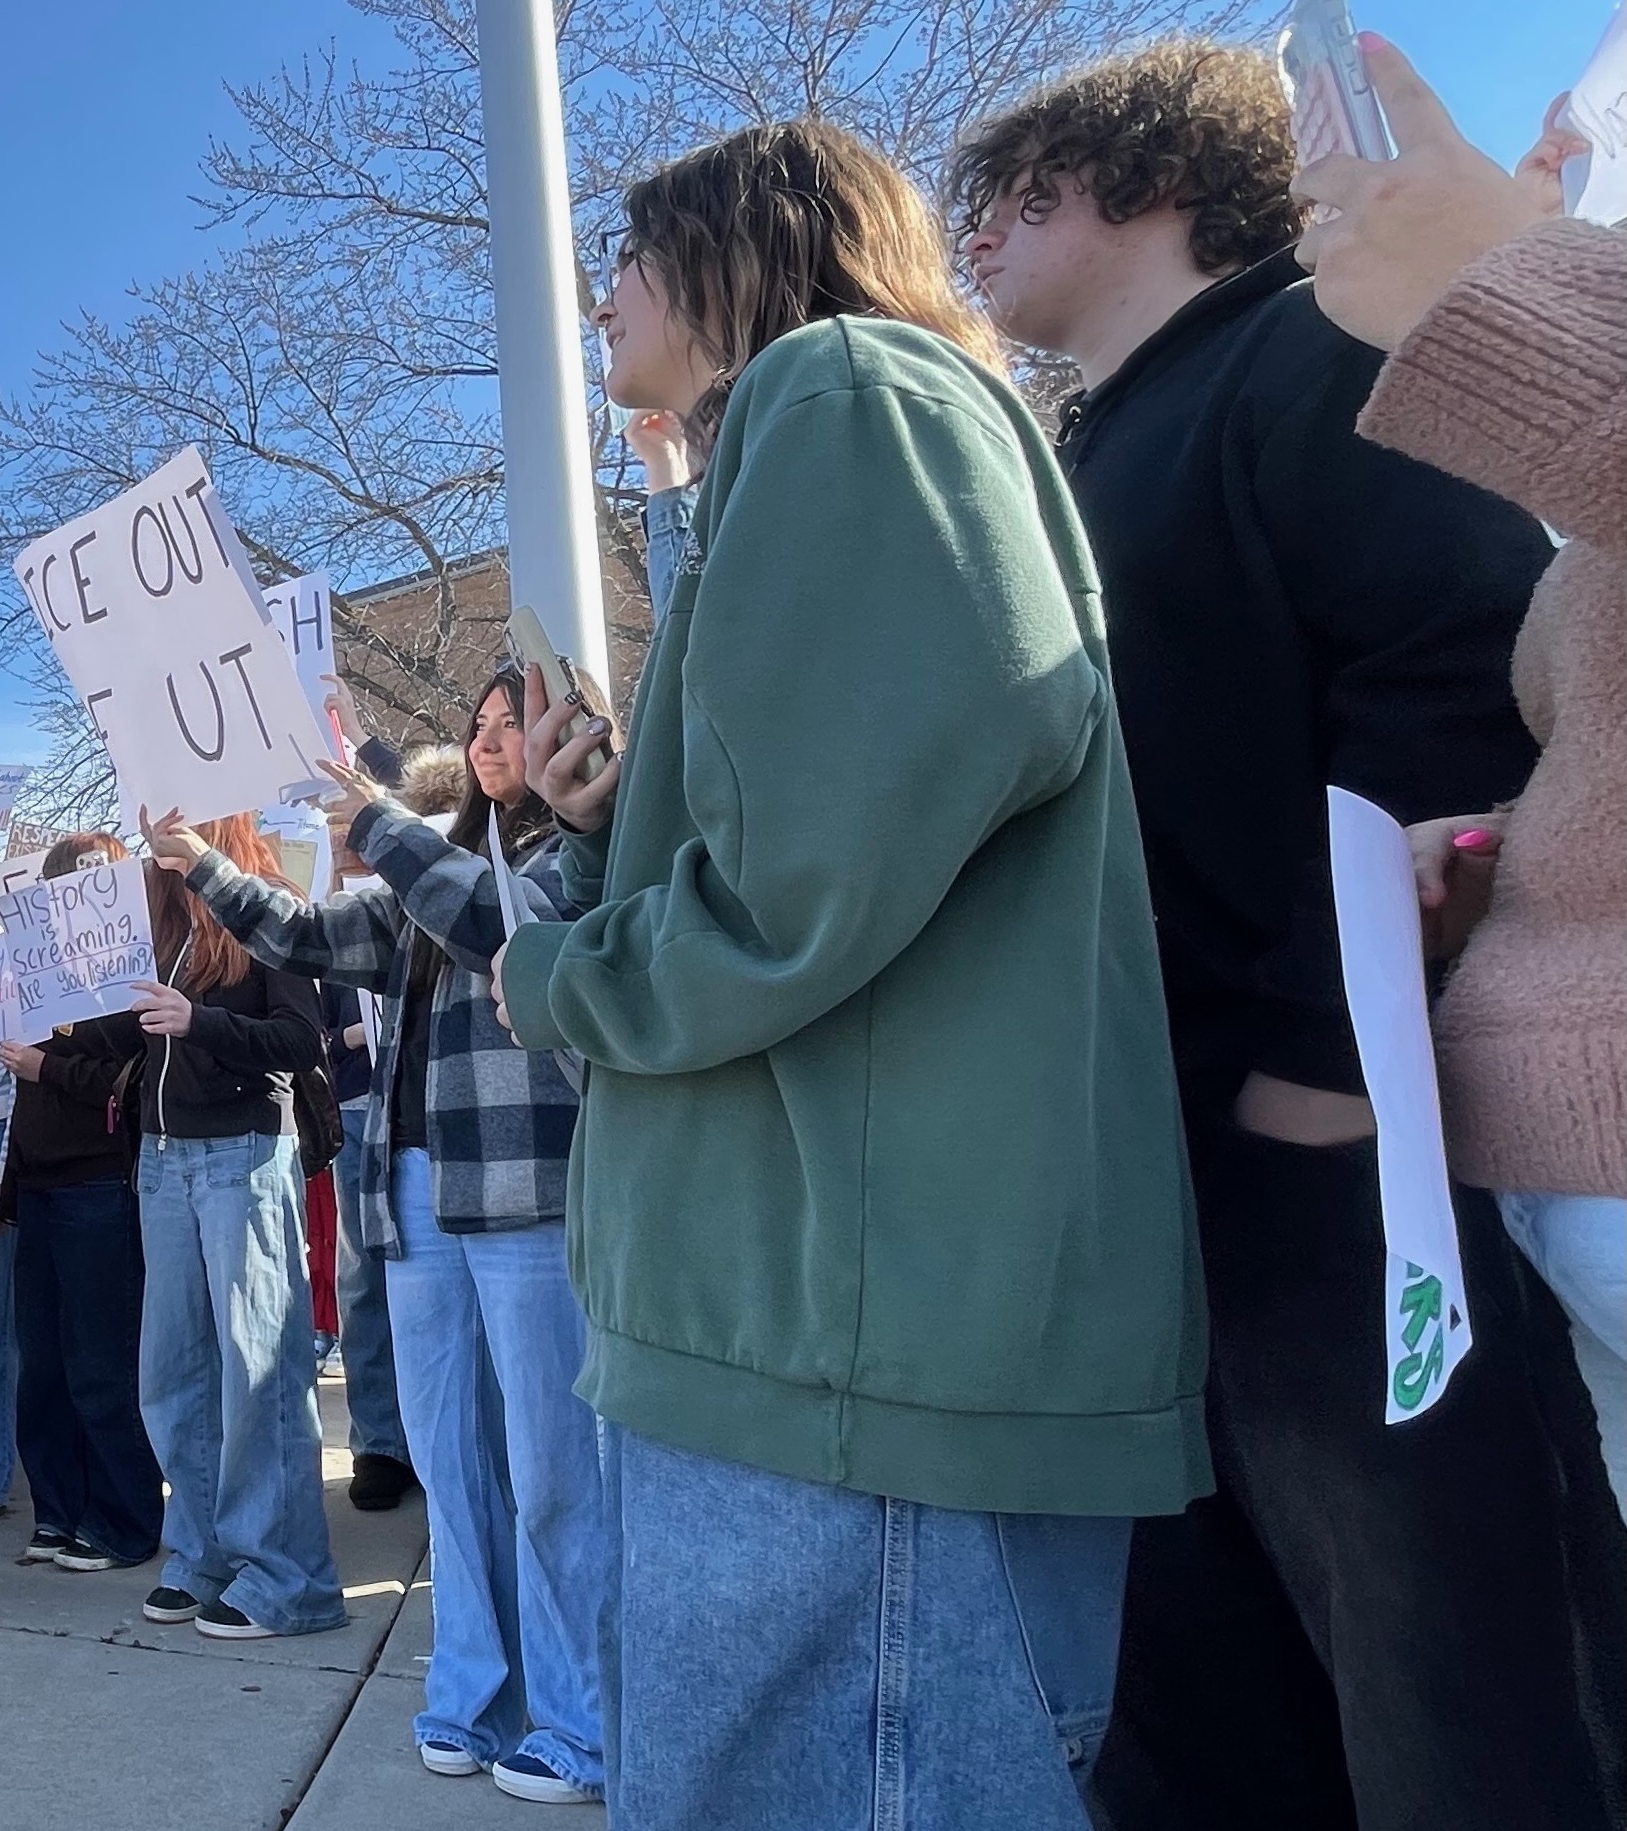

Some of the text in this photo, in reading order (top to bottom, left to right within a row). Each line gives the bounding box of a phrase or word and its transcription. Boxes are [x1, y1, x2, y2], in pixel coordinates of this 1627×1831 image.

[131, 477, 230, 598] OUT
[11, 822, 68, 847] RESPEC
[40, 923, 55, 941] is
[17, 979, 45, 1011] Are
